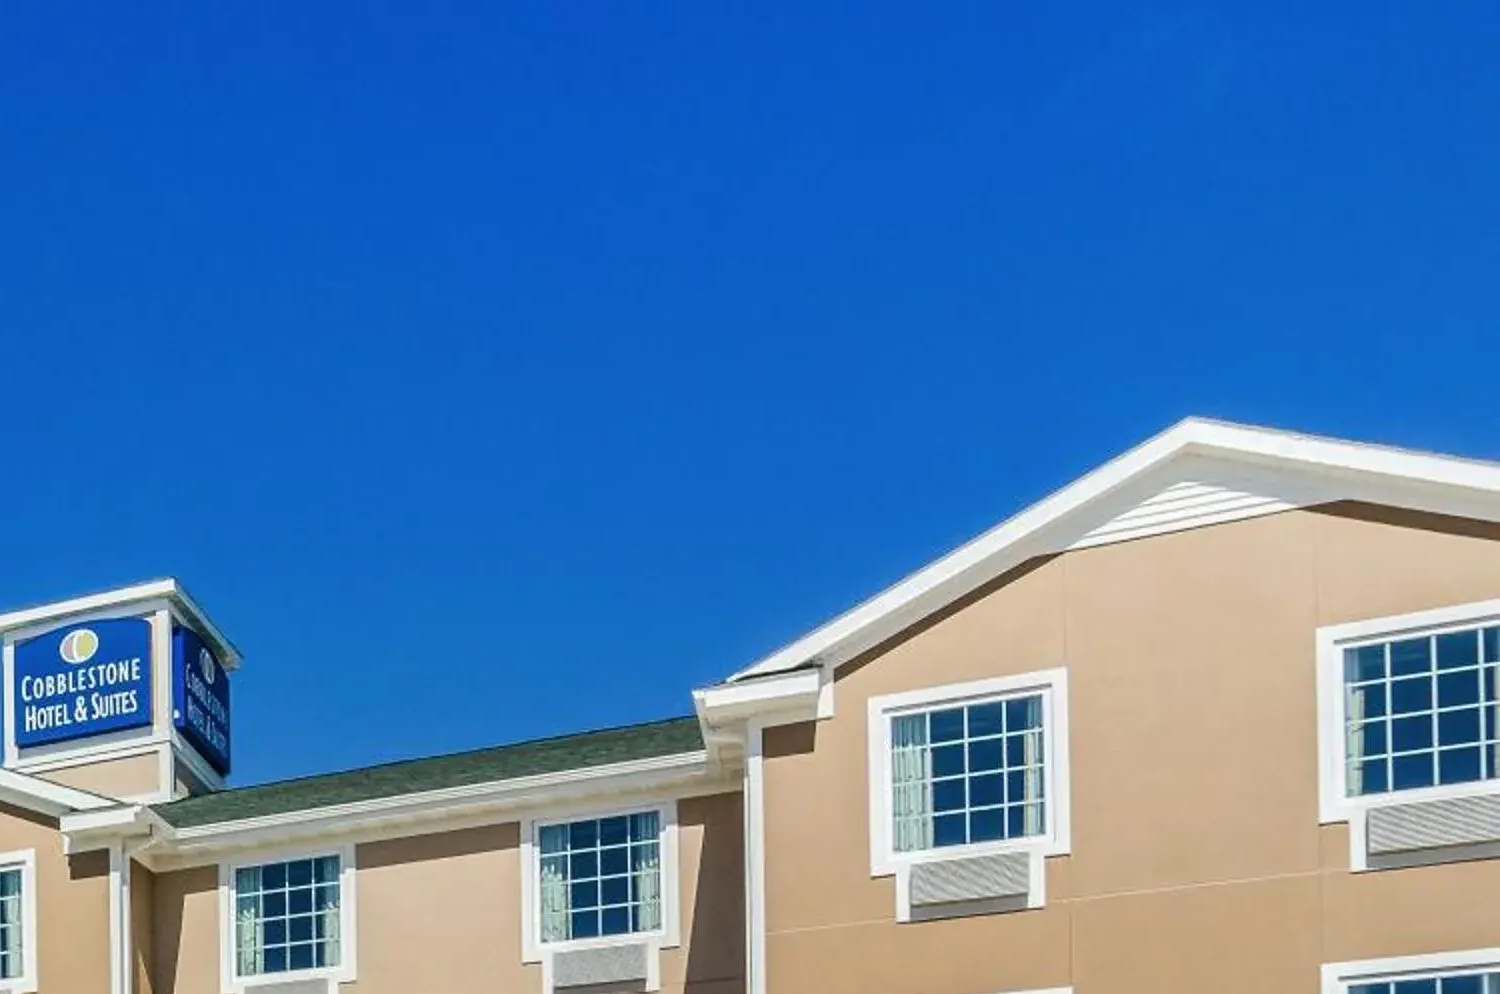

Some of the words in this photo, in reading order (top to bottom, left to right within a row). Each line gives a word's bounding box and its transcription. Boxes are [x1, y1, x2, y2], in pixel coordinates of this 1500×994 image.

[21, 657, 141, 702] COBBLESTONE
[25, 702, 71, 732] HOTEL
[74, 696, 88, 722] &
[91, 690, 138, 720] SUITES
